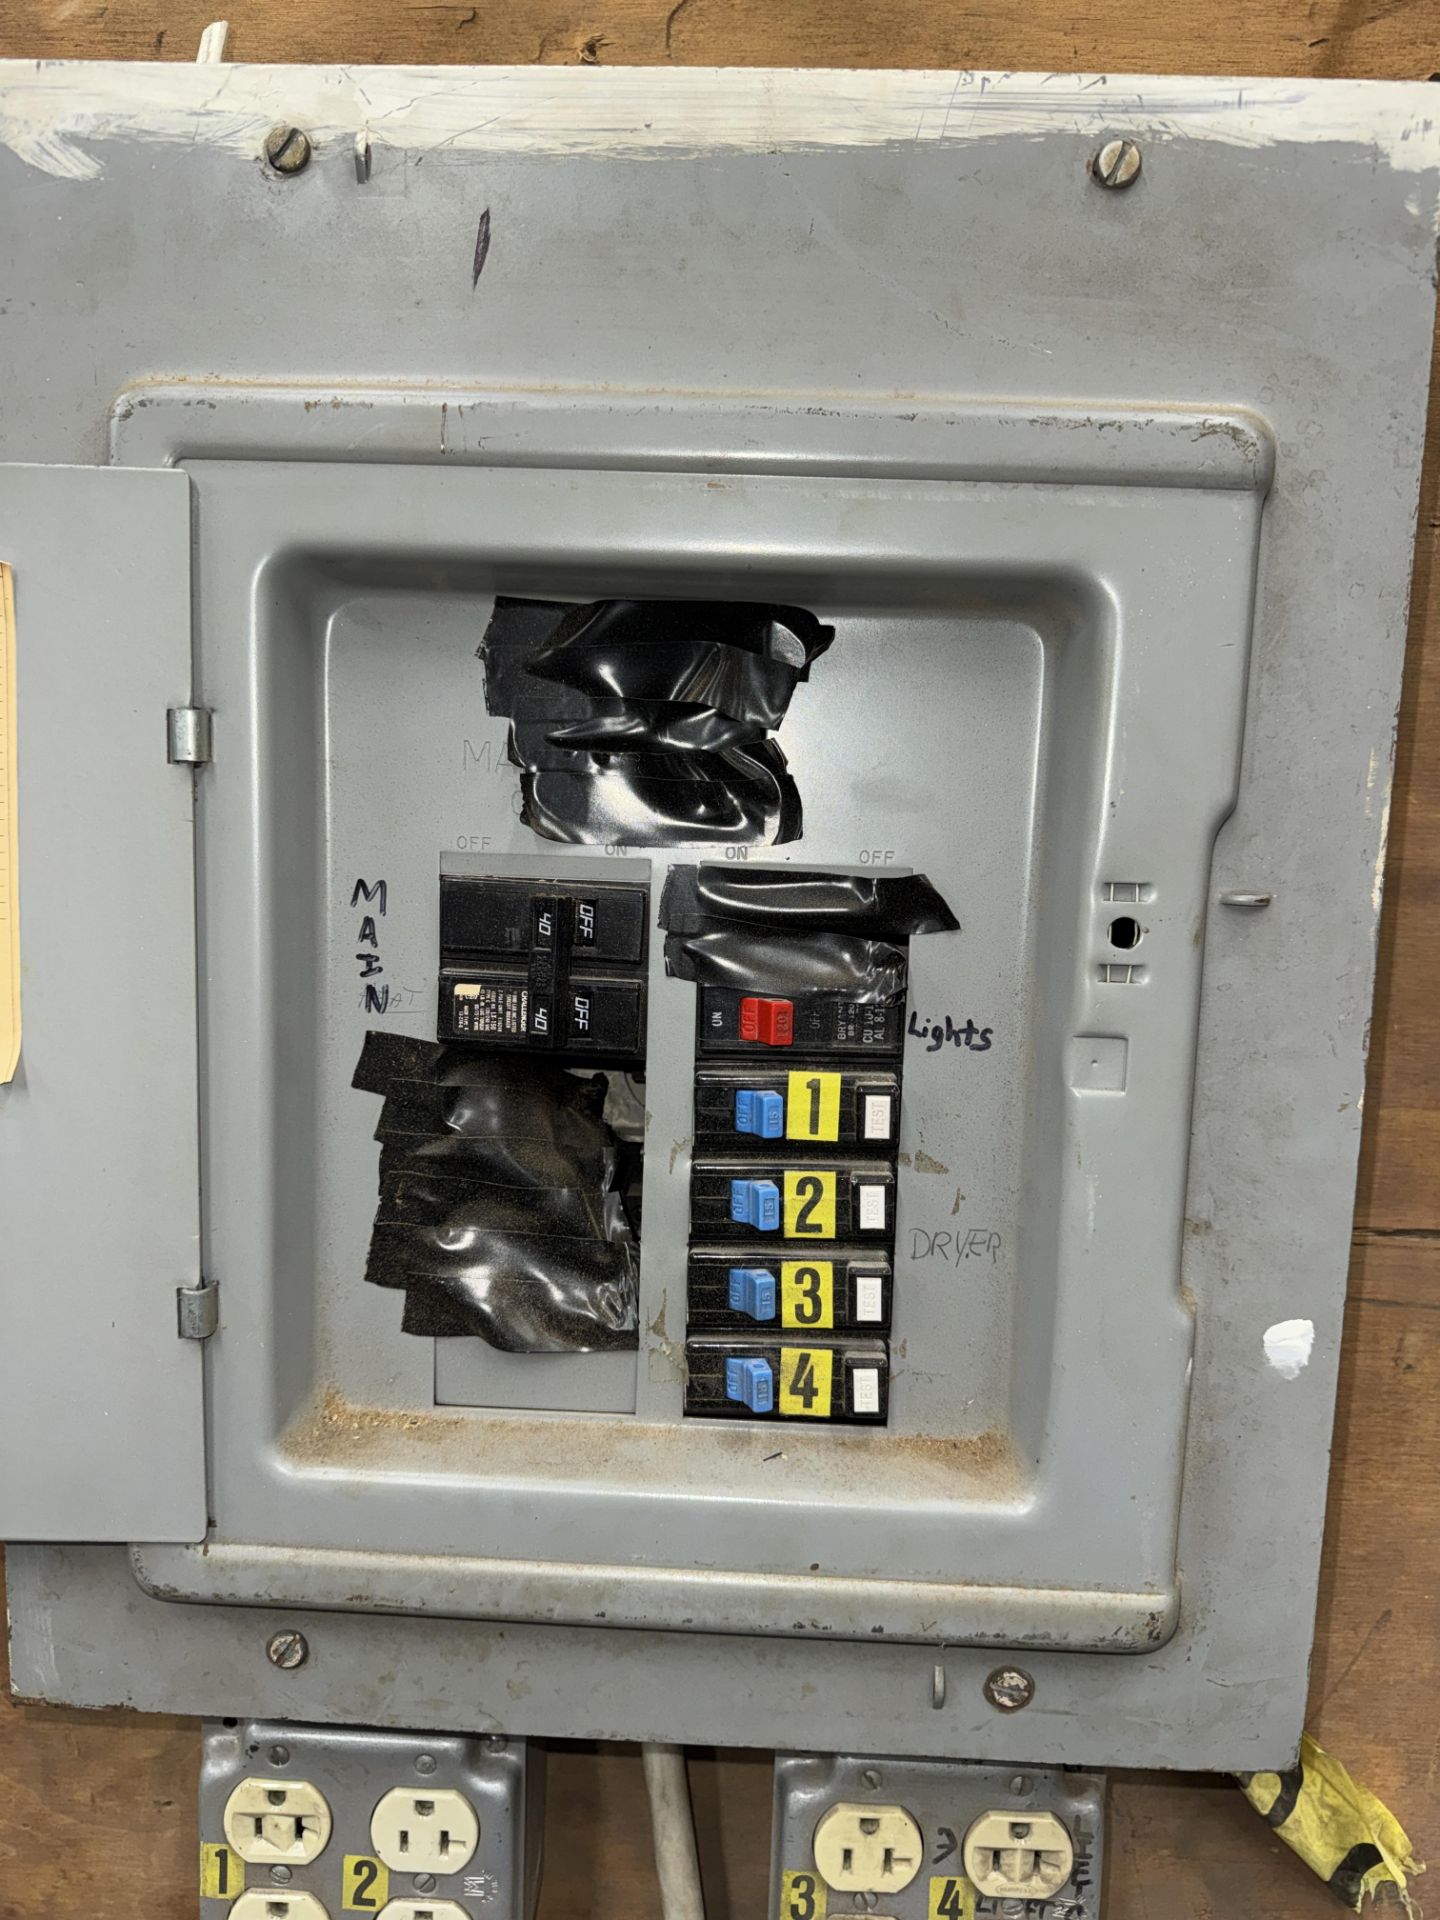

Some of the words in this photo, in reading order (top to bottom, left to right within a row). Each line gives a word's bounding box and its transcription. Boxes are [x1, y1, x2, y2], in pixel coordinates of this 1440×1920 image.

[456, 834, 493, 851] OFF
[604, 843, 628, 857] ON
[724, 845, 748, 860] ON
[858, 849, 896, 865] OFF
[538, 912, 552, 937] 40
[579, 903, 595, 939] OFF
[350, 878, 388, 1014] MAIN
[534, 1007, 548, 1032] 40
[574, 996, 590, 1031] OFF
[742, 1004, 756, 1034] OFF
[862, 1029, 874, 1043] CU
[873, 1027, 886, 1040] AL
[908, 1010, 994, 1052] Lights
[737, 1097, 748, 1128] OFF
[805, 1077, 822, 1136] 1
[872, 1102, 886, 1134] TEST
[732, 1188, 745, 1216] OFF
[795, 1176, 824, 1234] 2
[867, 1191, 881, 1223] TEST
[908, 1227, 1002, 1268] DRYER
[794, 1266, 823, 1325] 3
[863, 1283, 877, 1317] TEST
[789, 1352, 819, 1409] 4
[860, 1376, 874, 1409] TEST
[214, 1848, 228, 1895] 1
[352, 1859, 378, 1908] 2
[789, 1874, 816, 1920] 3
[936, 1879, 964, 1920] 4
